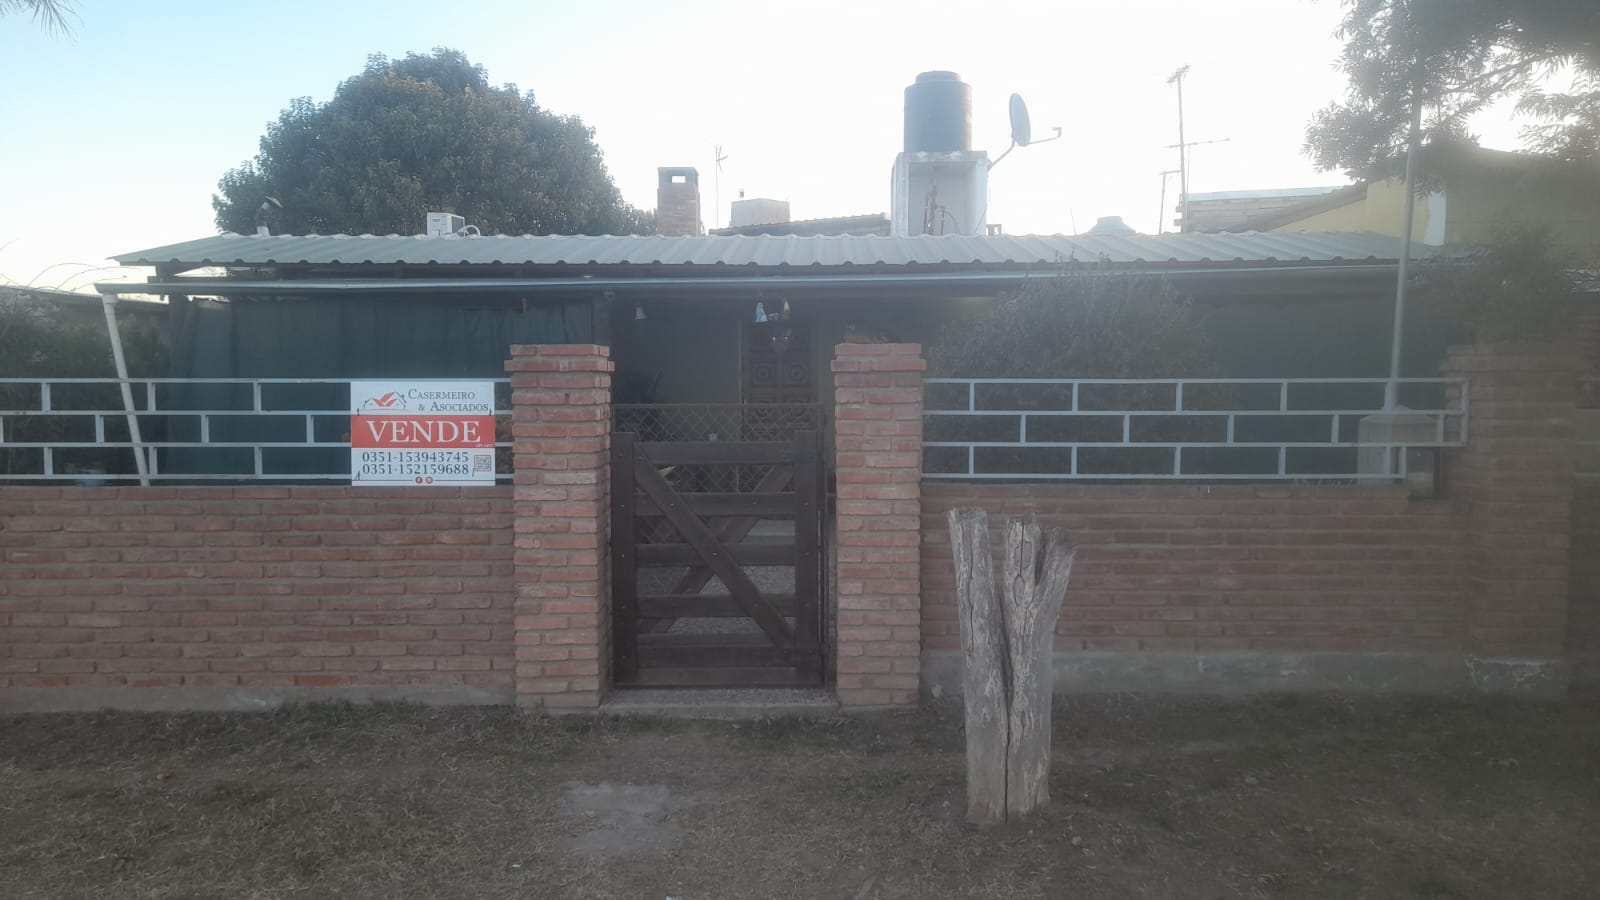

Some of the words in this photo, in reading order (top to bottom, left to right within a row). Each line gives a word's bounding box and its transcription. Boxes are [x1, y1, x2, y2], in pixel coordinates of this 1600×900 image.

[366, 420, 481, 443] VENDE
[362, 451, 469, 463] 0351-153943745
[362, 463, 469, 475] 0351-152159688
